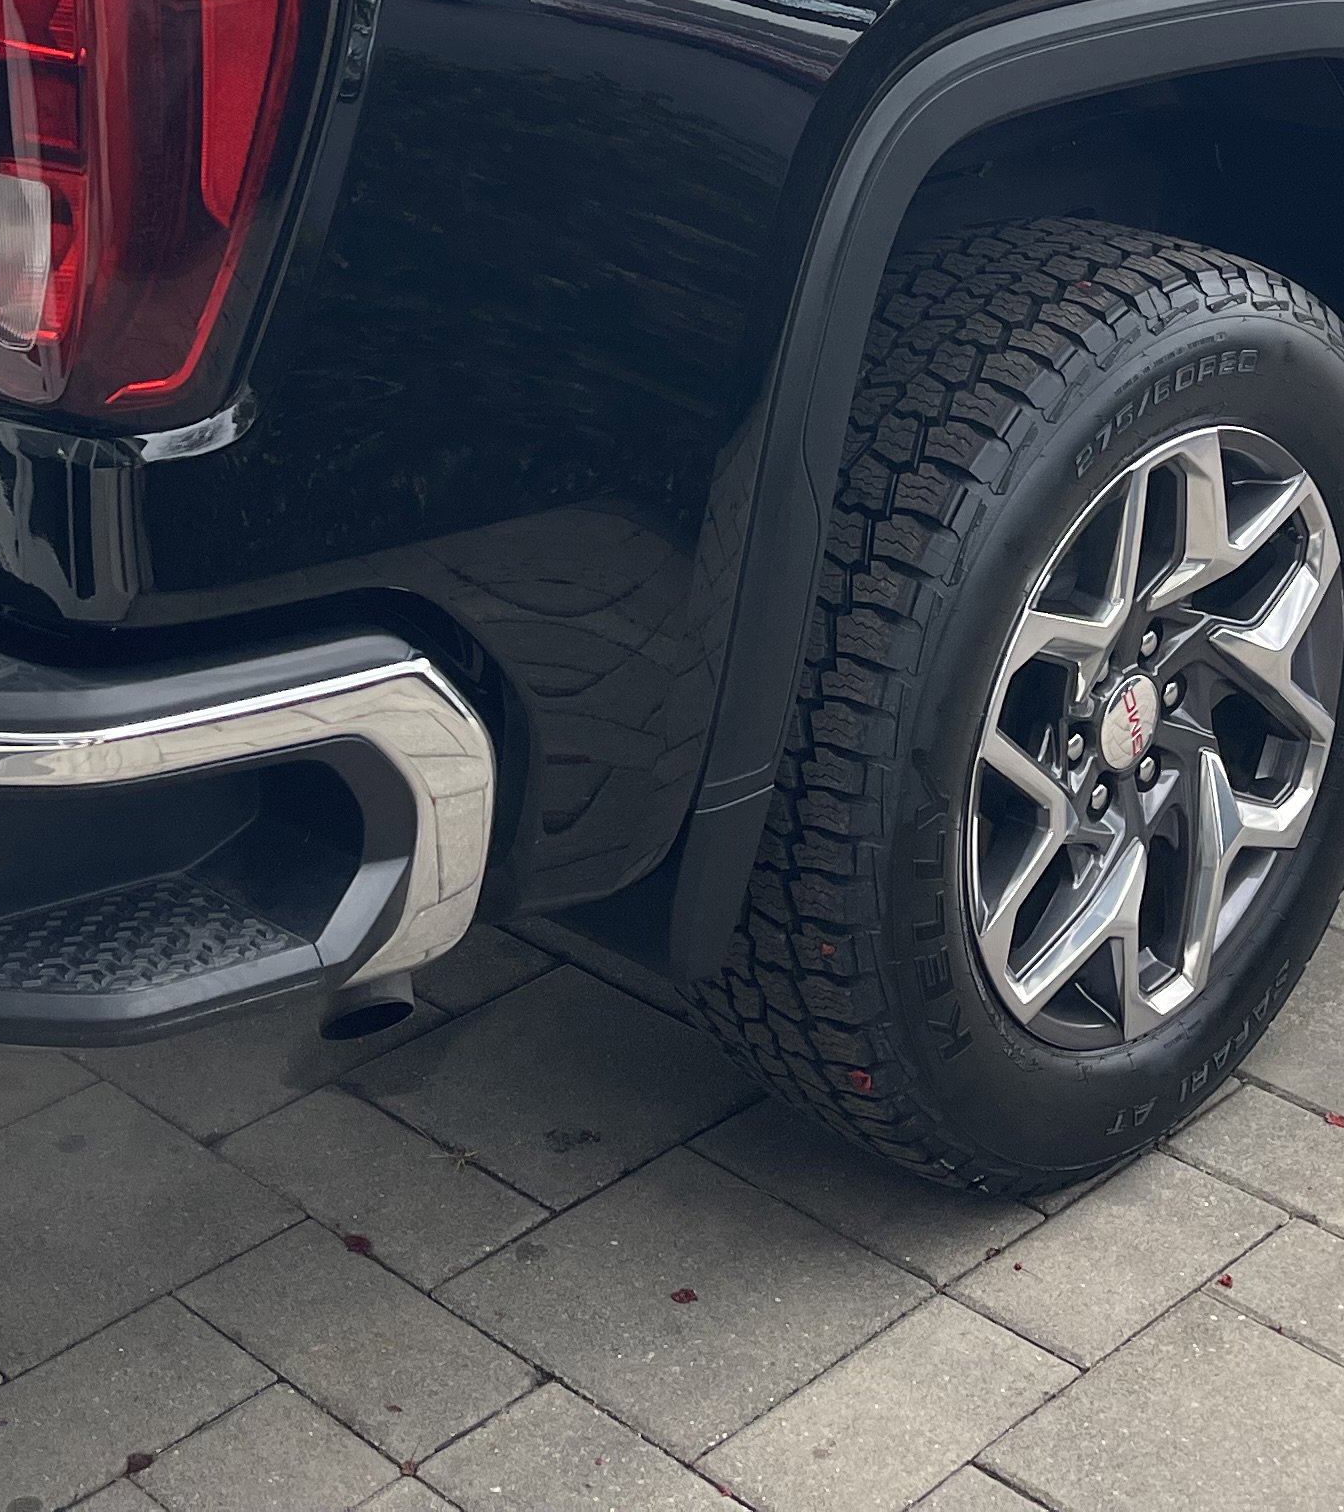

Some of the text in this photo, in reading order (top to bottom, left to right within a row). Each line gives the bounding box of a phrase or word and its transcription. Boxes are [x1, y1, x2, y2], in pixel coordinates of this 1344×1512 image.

[1122, 687, 1143, 759] GMC
[912, 773, 973, 1063] KELLY
[1105, 1096, 1158, 1136] AT
